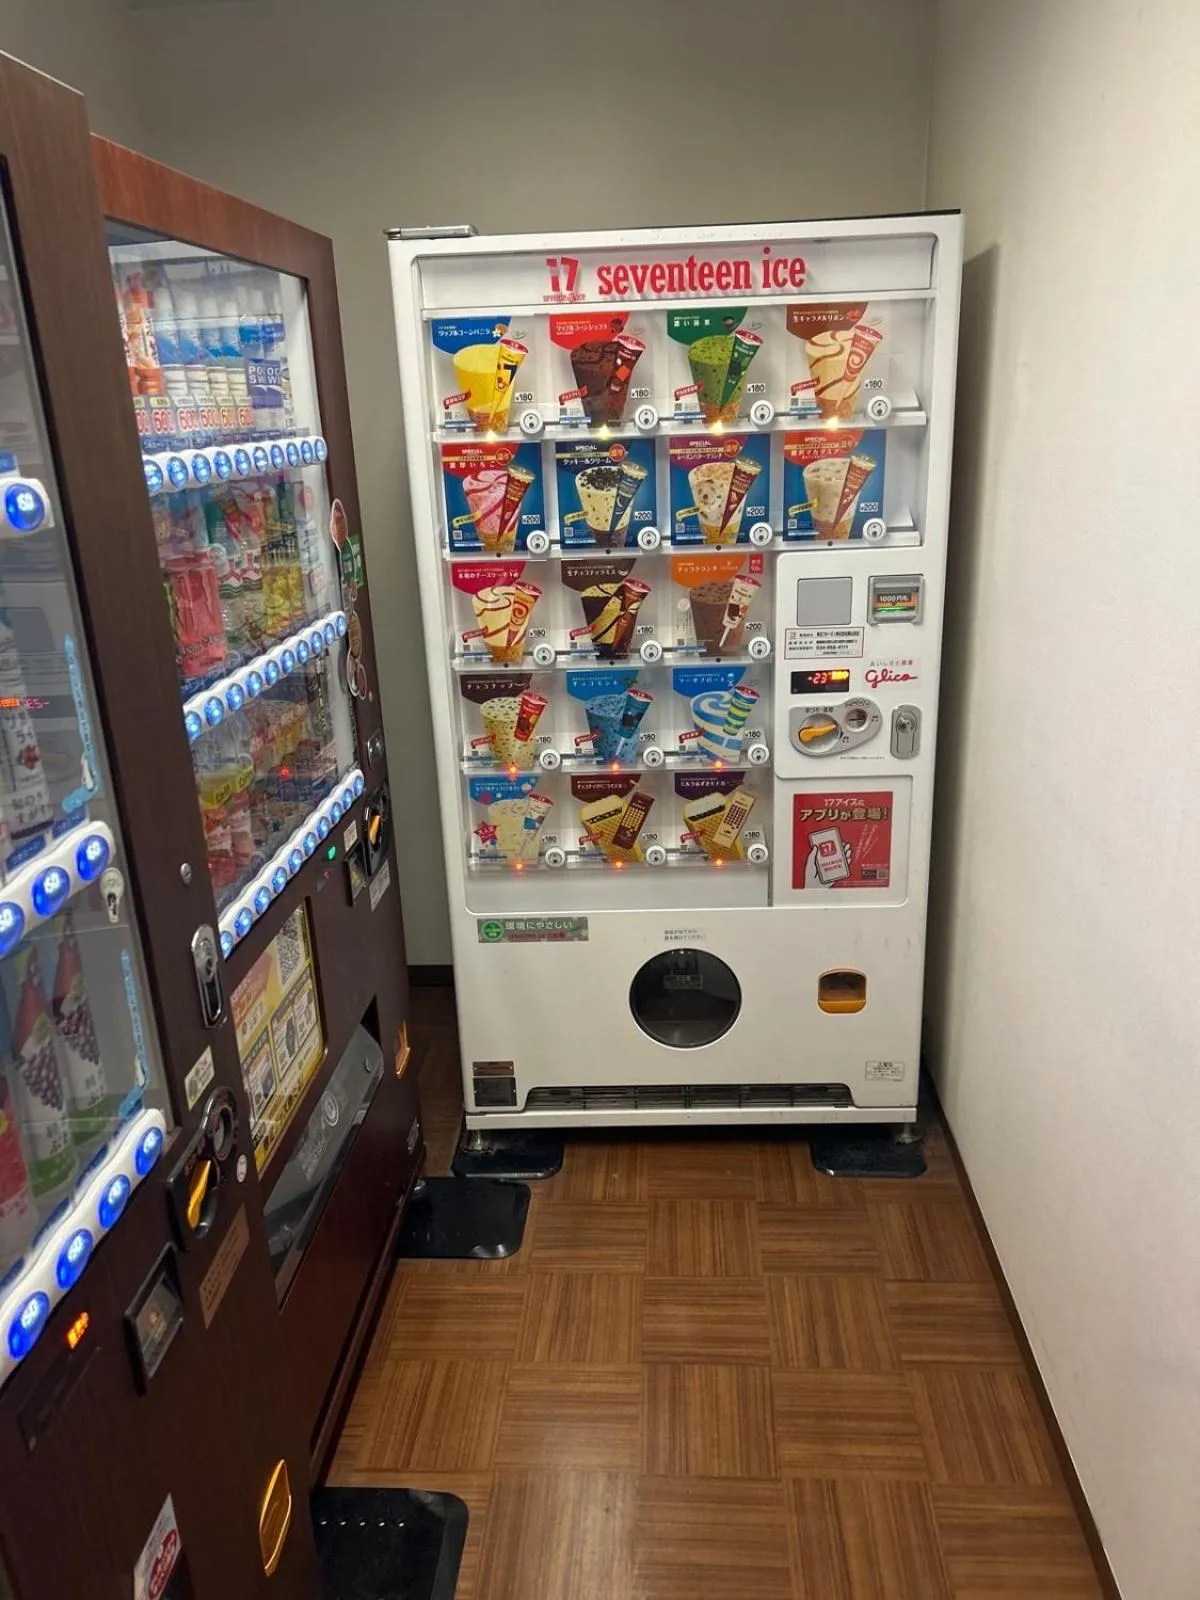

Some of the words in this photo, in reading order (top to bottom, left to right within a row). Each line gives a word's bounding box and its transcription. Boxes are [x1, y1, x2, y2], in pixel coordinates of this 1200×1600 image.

[546, 257, 579, 292] 17
[597, 256, 751, 295] seventeen
[762, 247, 807, 289] ice
[748, 384, 765, 393] ¥180
[865, 379, 883, 389] ¥180
[632, 389, 648, 398] ¥180
[747, 506, 765, 515] ¥200
[860, 502, 878, 511] ¥200
[523, 515, 540, 524] ¥200
[635, 511, 652, 521] ¥200
[638, 625, 654, 635] ¥180
[865, 668, 918, 689] Glico
